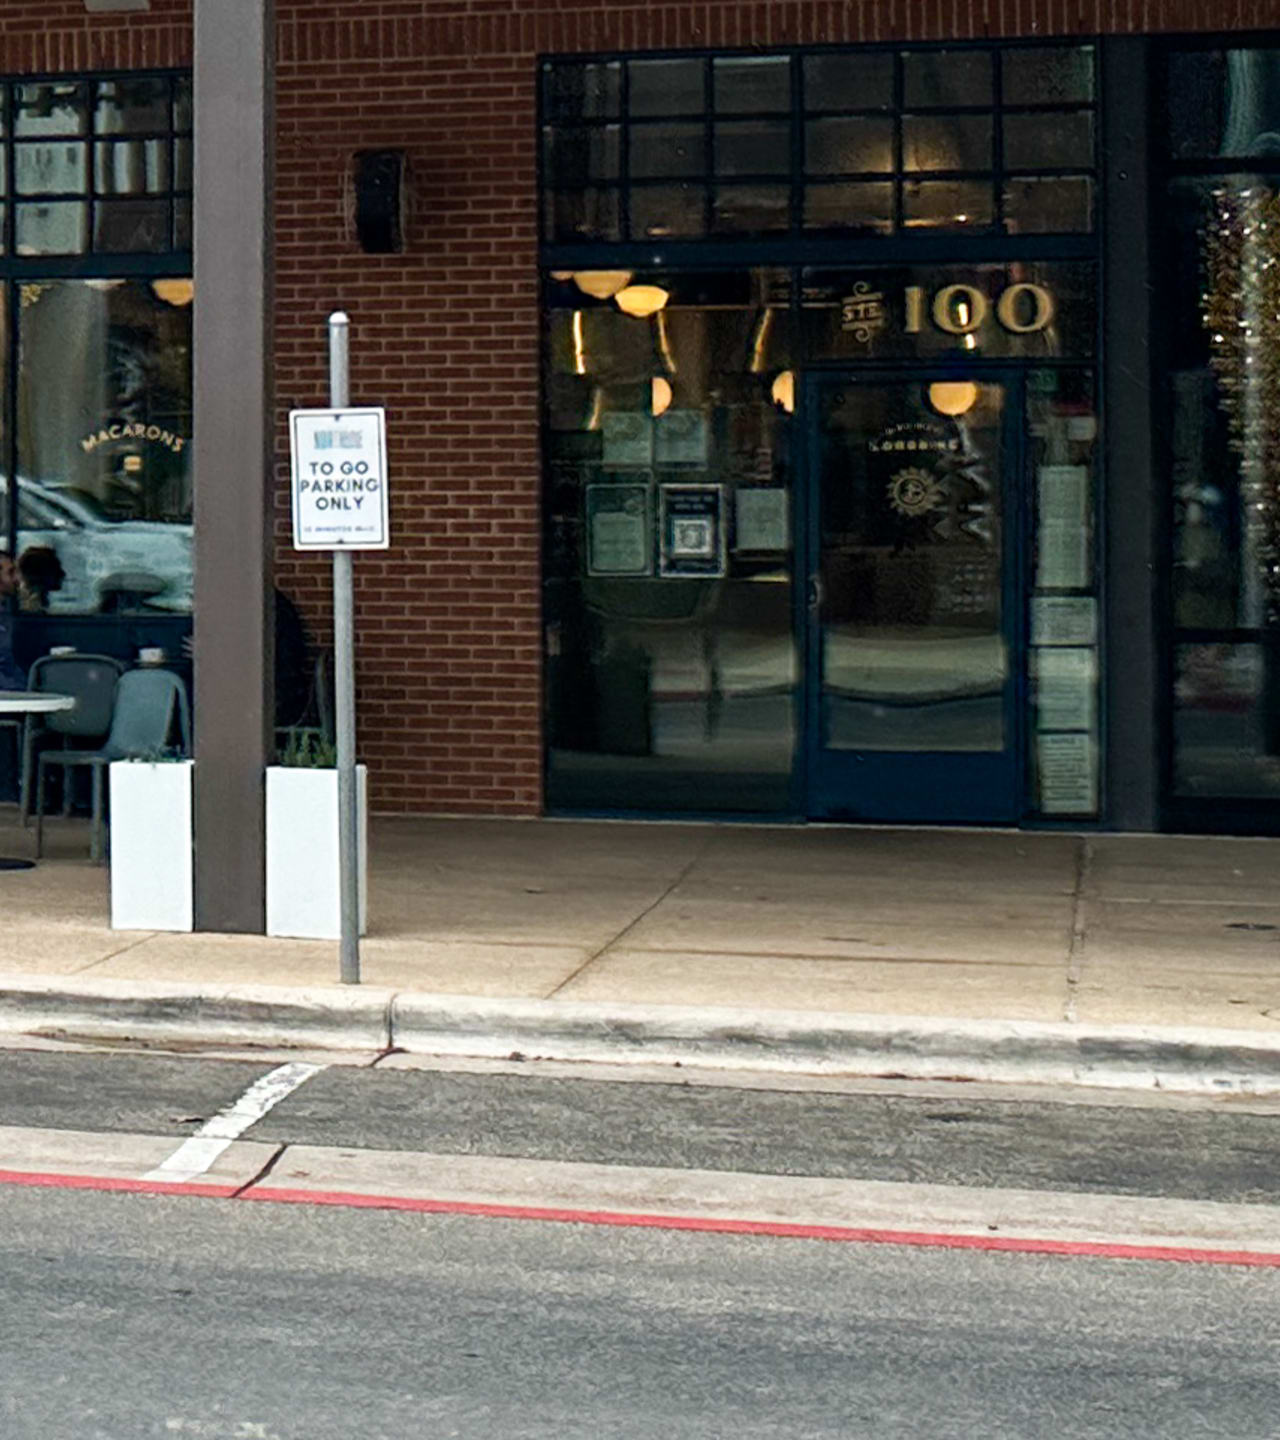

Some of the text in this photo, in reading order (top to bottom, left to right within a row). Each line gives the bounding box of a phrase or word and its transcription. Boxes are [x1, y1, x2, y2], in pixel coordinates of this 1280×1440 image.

[905, 283, 1054, 334] 100
[81, 423, 183, 453] MACARONS
[309, 461, 369, 476] TO GO
[300, 478, 378, 493] PARKING
[315, 496, 364, 511] ONLY
